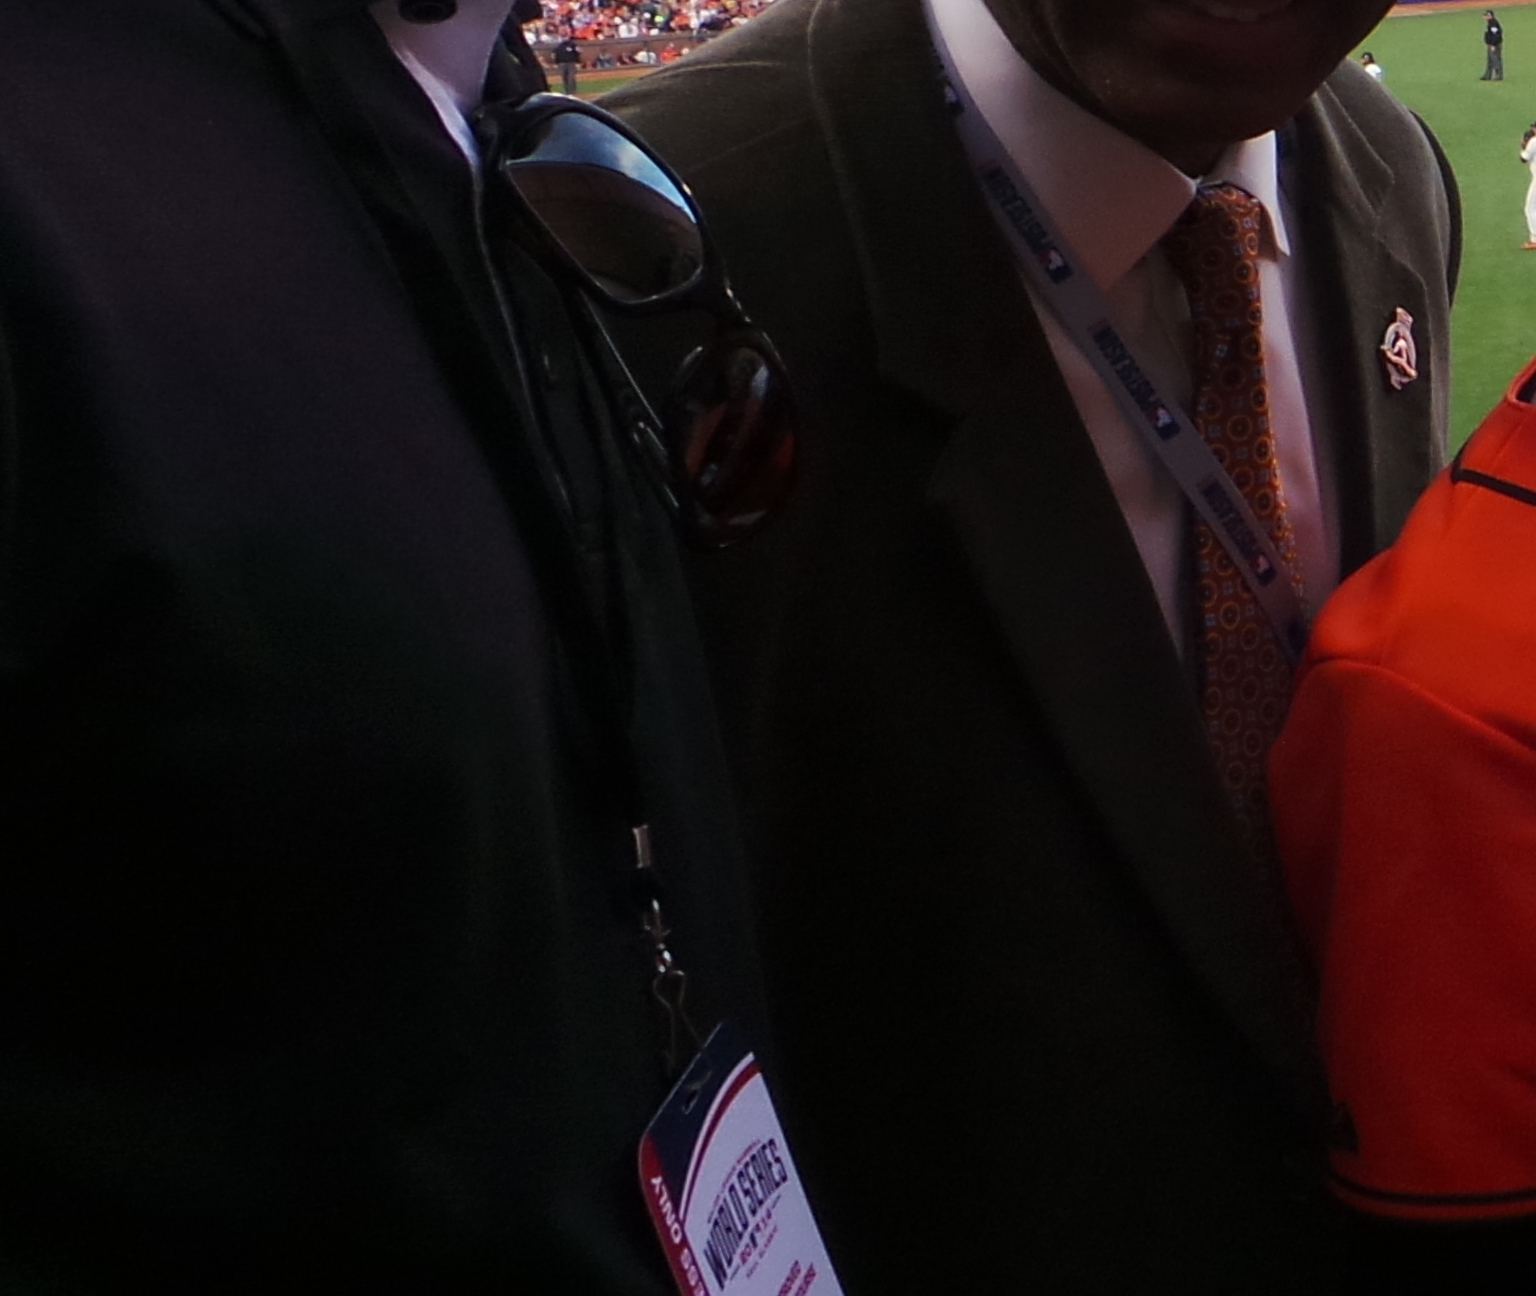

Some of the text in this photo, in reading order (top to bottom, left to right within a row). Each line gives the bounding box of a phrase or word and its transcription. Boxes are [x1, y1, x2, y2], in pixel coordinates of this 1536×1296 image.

[651, 1175, 682, 1245] ONLY
[703, 1183, 749, 1292] WORLD
[737, 1138, 788, 1217] SERIES
